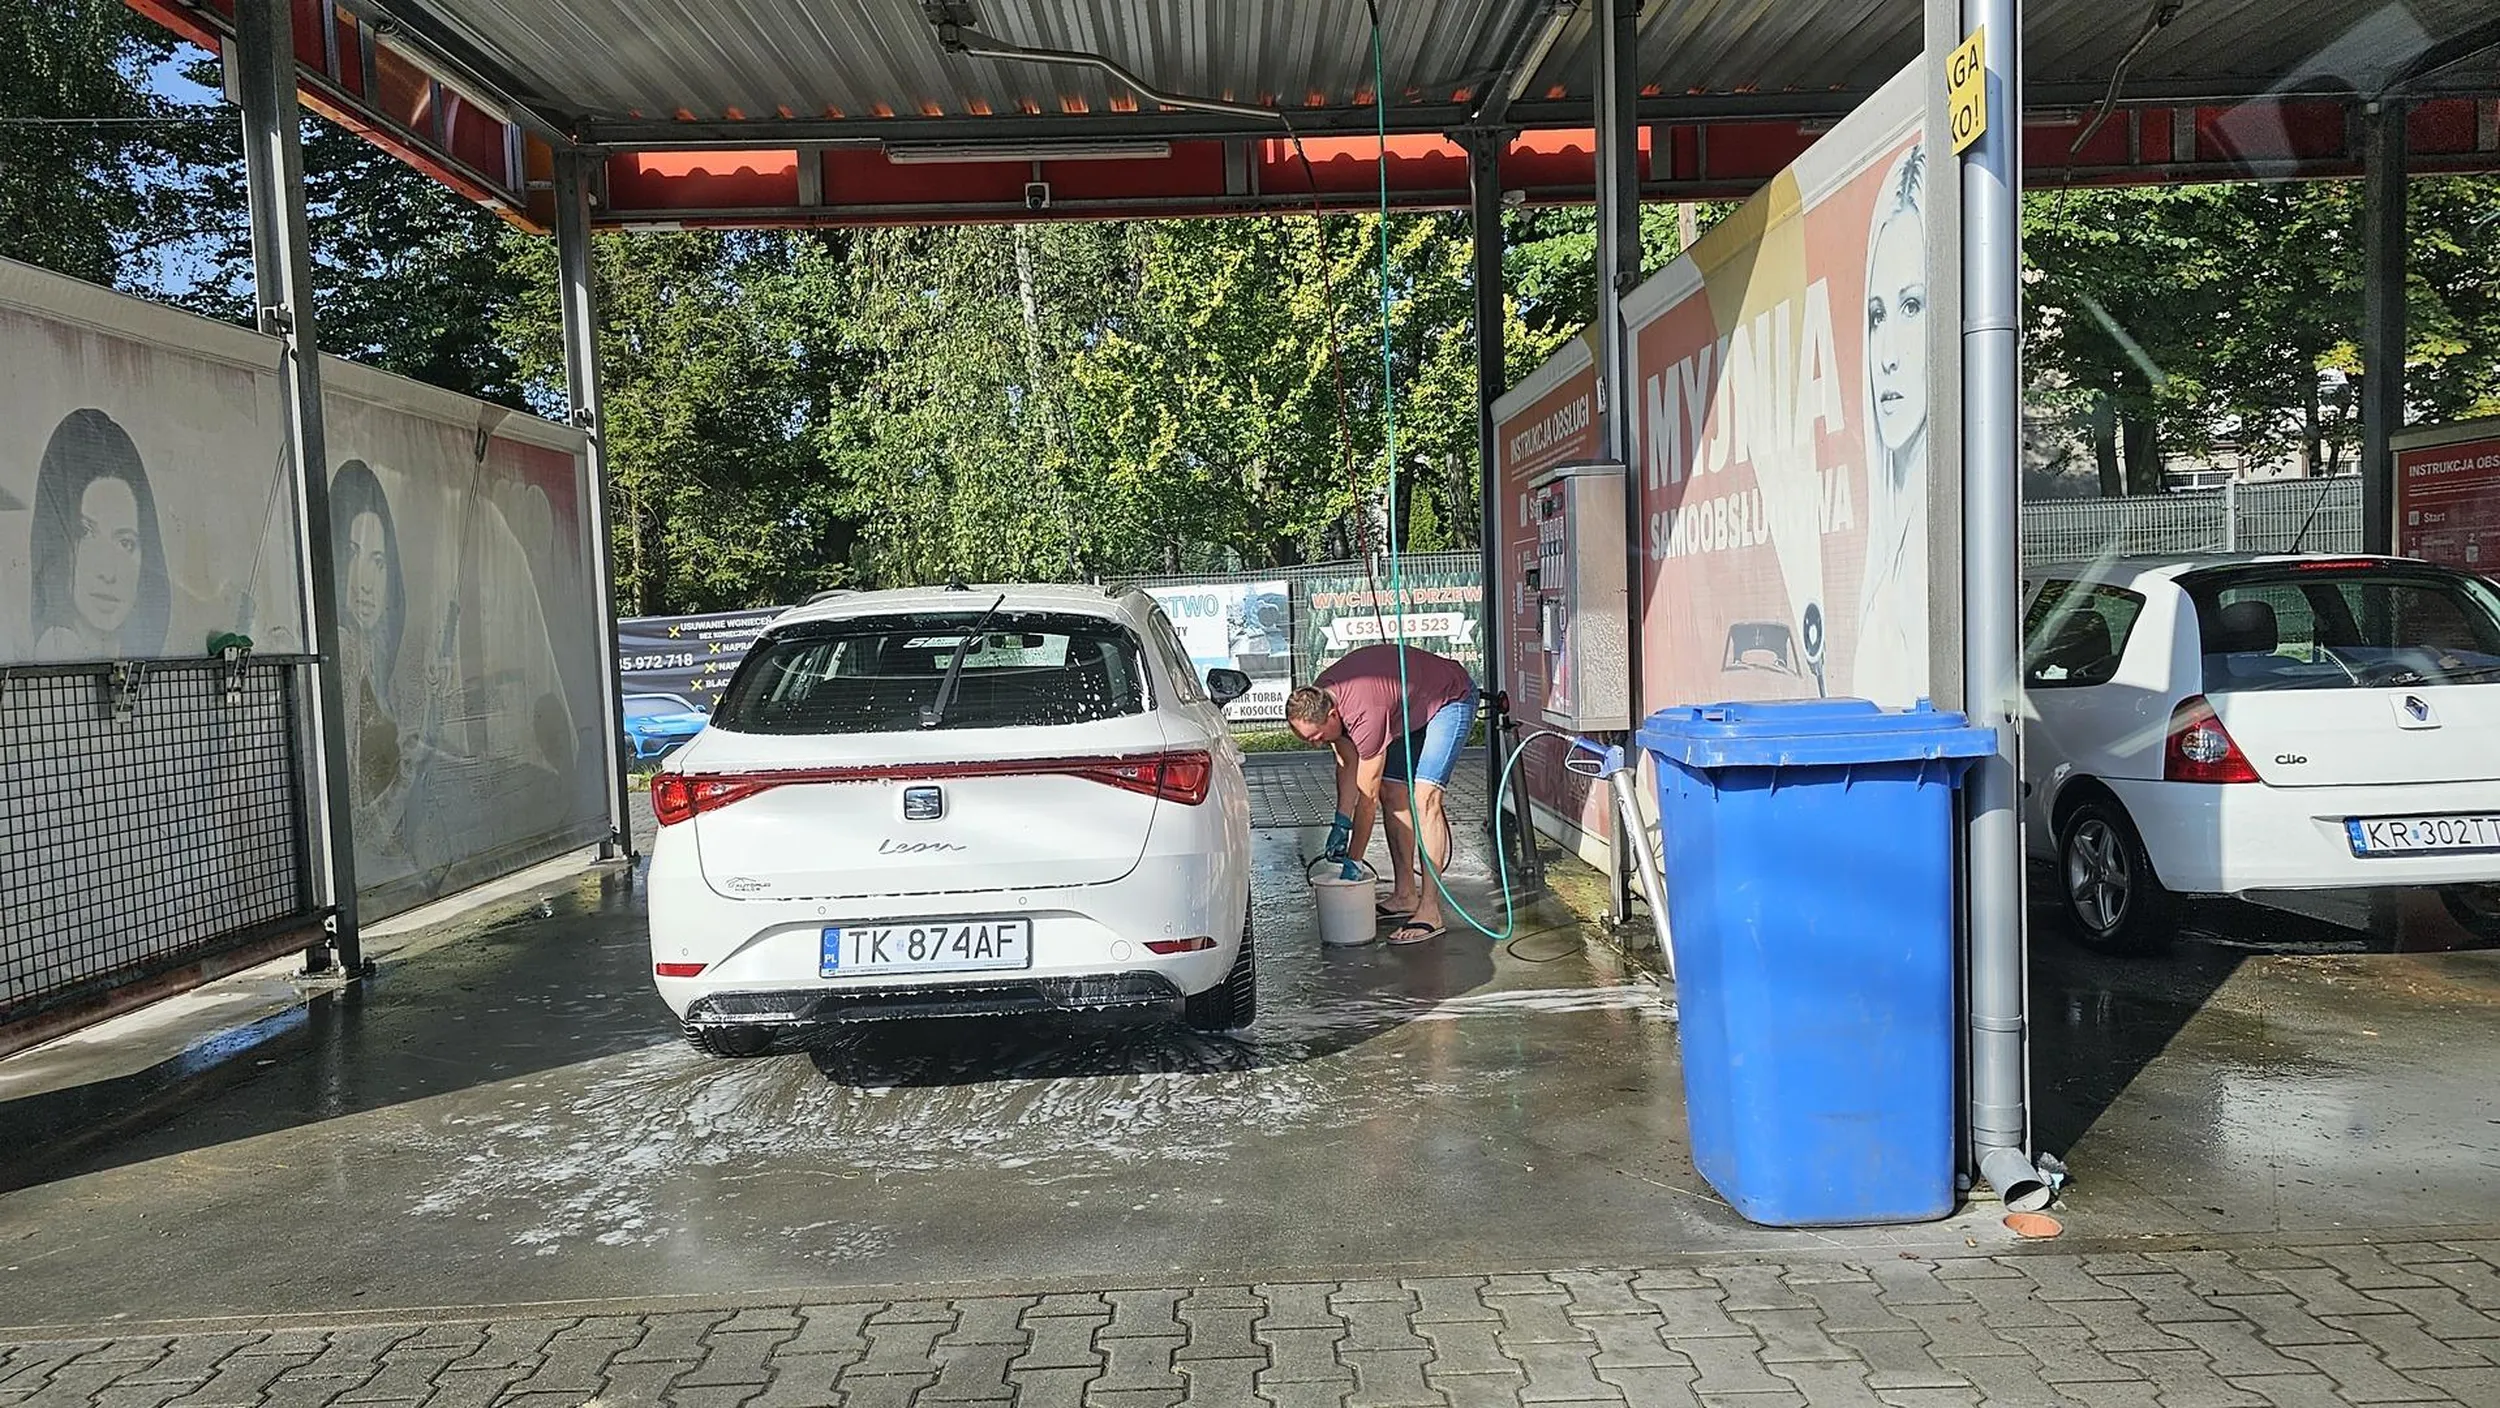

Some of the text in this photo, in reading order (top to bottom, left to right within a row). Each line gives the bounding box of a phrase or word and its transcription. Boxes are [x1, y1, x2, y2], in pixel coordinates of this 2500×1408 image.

[1647, 277, 1845, 491] MYJNIA
[1510, 393, 1590, 465] INSTRUKCJA OBSŁUGI
[2408, 458, 2475, 477] INSTRUKCJA
[2424, 512, 2445, 523] Start
[1312, 586, 1482, 609] WYCINKA DRZEW
[680, 620, 726, 631] USUWANIE
[1388, 619, 1417, 633] 03
[1421, 617, 1449, 631] 523
[635, 655, 664, 669] 972
[665, 653, 693, 668] 718
[1252, 691, 1283, 702] TORBA
[1240, 705, 1283, 716] KOSOCICE
[2275, 754, 2308, 765] Clio
[2366, 818, 2500, 848] KR 302TT
[878, 838, 968, 855] Leon
[848, 924, 1016, 964] TK 874AF
[824, 953, 838, 963] PL
